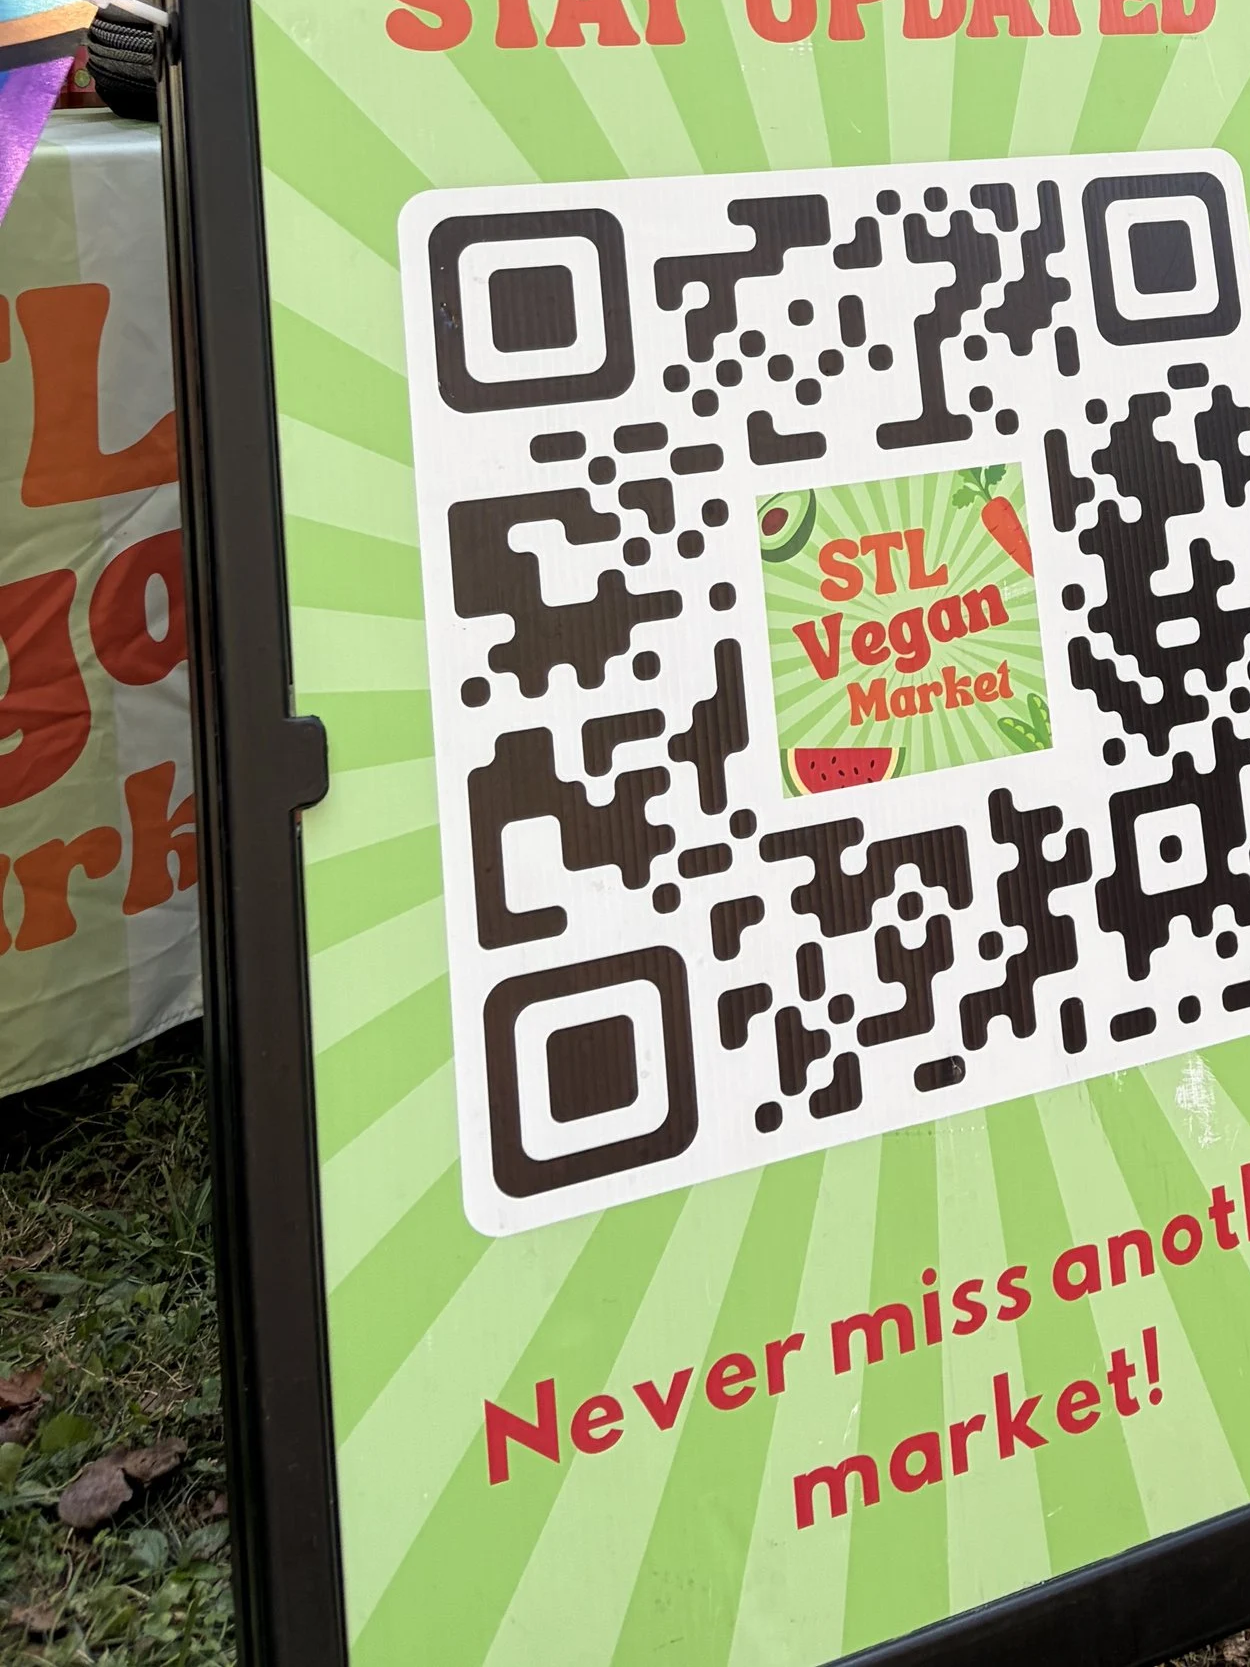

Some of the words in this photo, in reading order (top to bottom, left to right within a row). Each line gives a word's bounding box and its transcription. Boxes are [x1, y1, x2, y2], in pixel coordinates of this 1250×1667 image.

[817, 527, 949, 602] STL
[792, 584, 1010, 681] Vegan
[846, 659, 1015, 727] Market
[484, 1331, 806, 1485] Never
[830, 1267, 1034, 1376] miss
[792, 1325, 1165, 1531] market!
